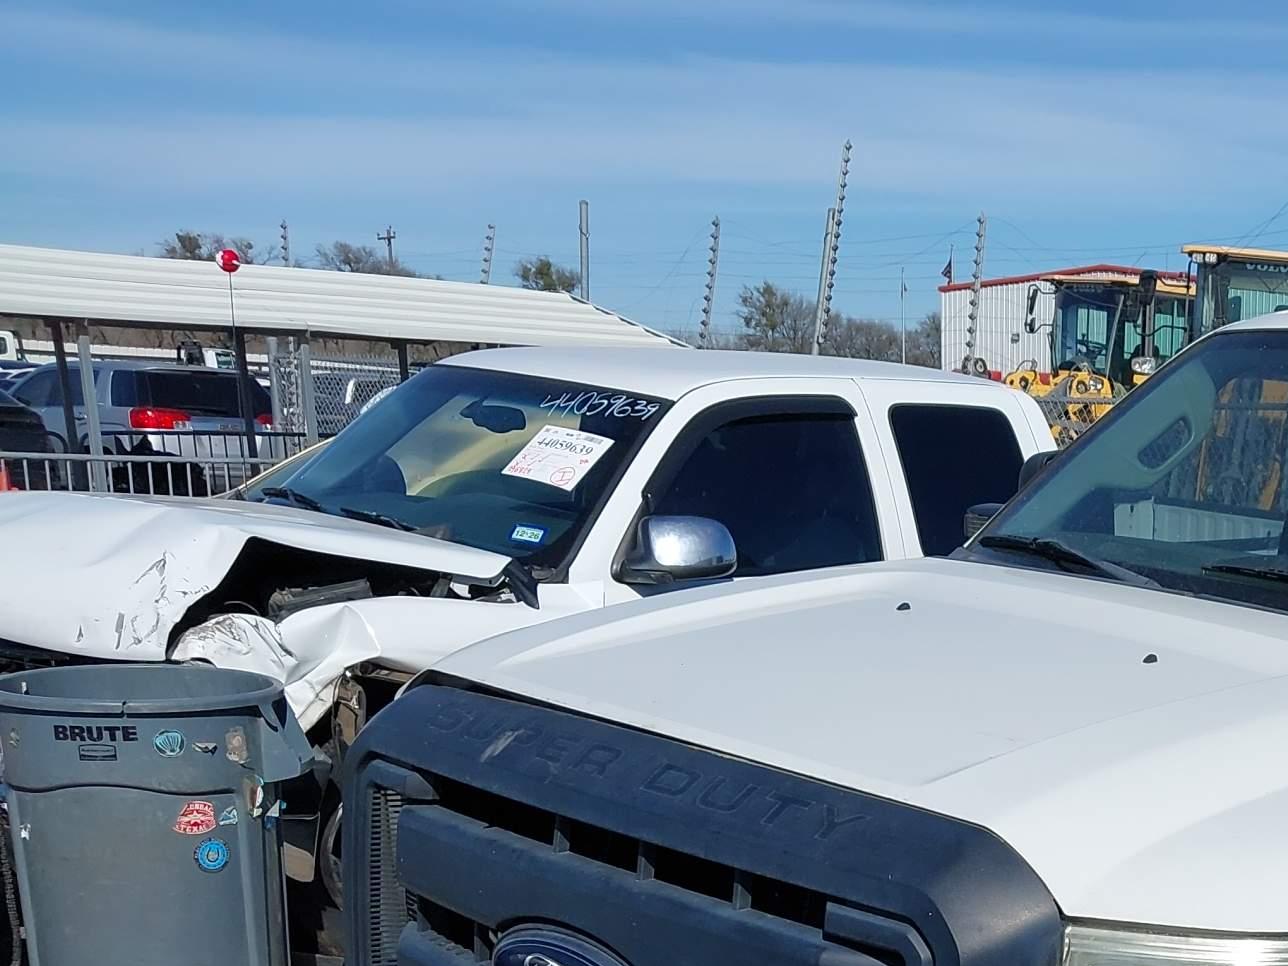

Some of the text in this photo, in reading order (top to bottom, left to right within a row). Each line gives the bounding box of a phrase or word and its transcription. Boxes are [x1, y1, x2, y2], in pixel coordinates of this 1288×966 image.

[540, 391, 660, 420] 44059639
[537, 436, 594, 456] 44059639
[53, 725, 138, 742] BRUTE
[637, 761, 872, 841] DUTY
